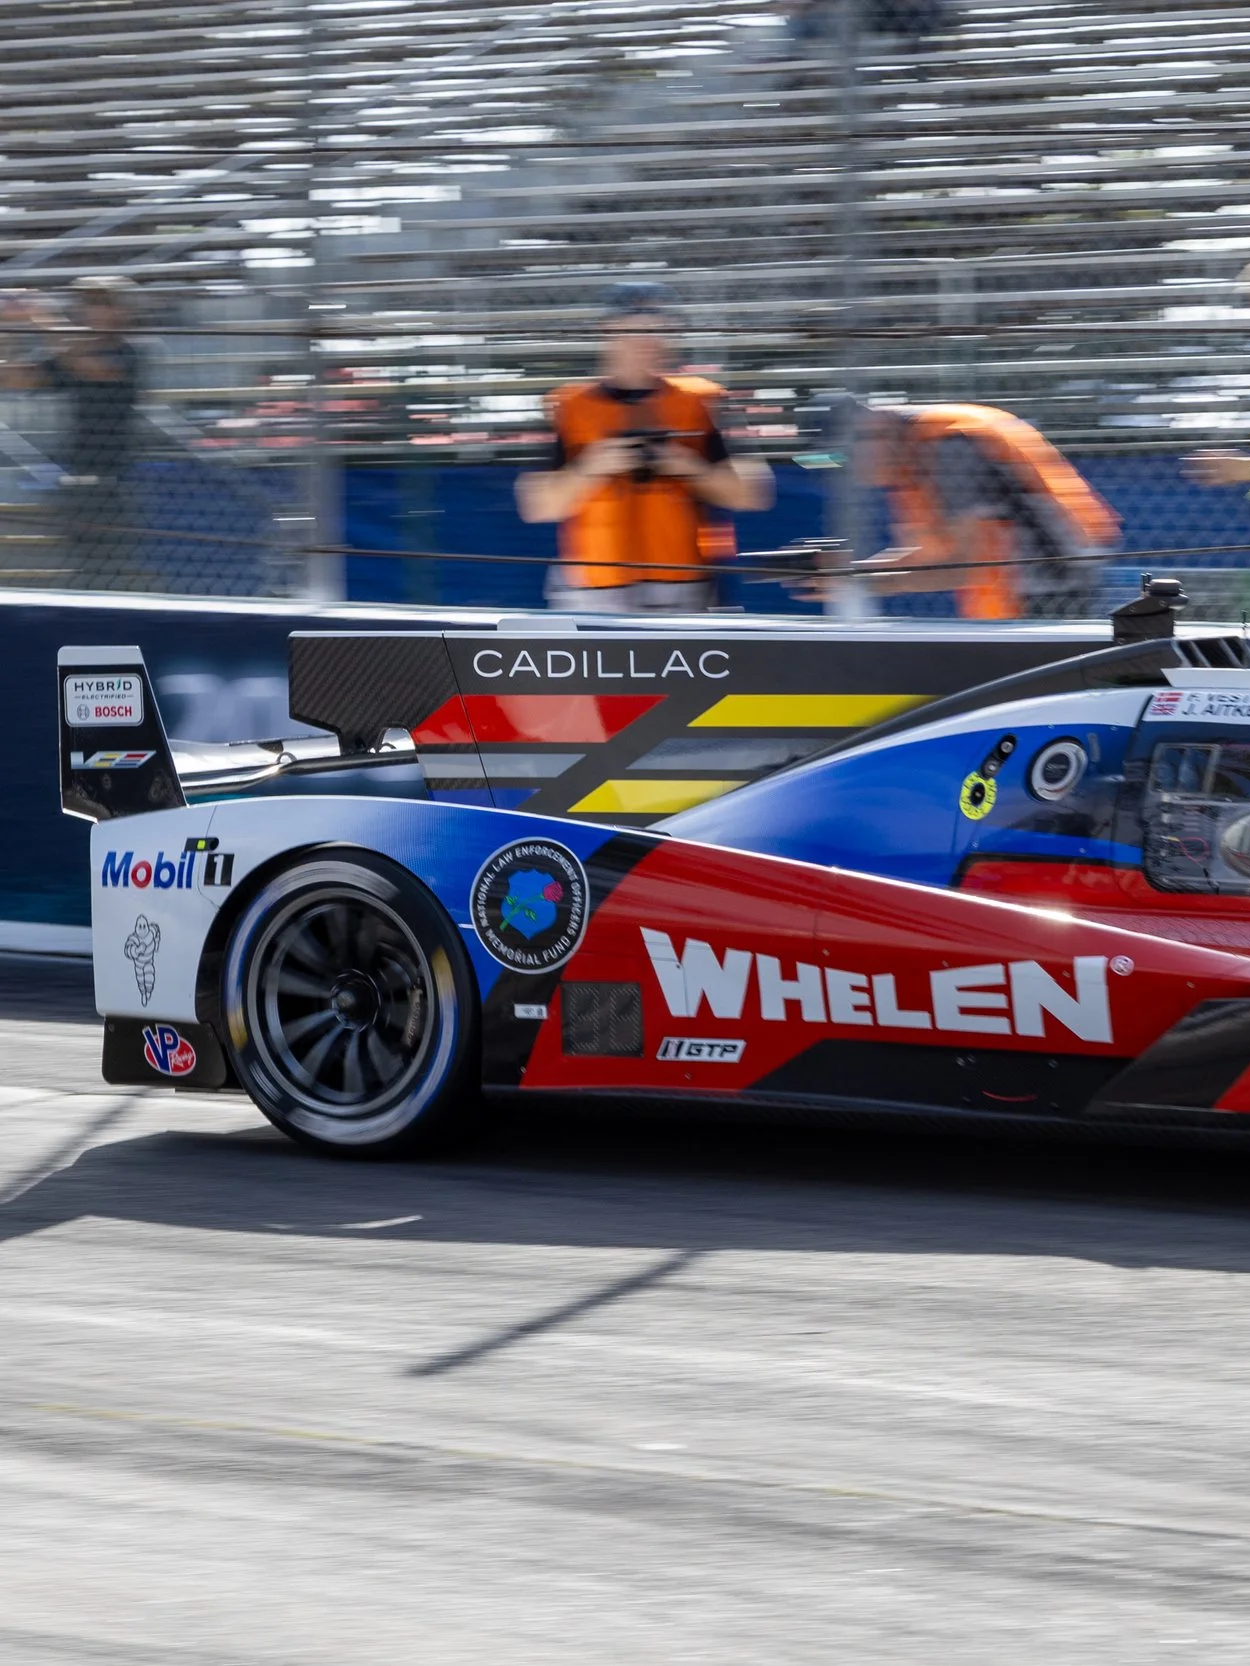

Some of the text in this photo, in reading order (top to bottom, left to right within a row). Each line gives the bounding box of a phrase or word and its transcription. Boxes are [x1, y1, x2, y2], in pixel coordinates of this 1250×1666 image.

[473, 650, 730, 678] CADILLAC
[74, 677, 132, 692] HYBRID
[95, 705, 132, 717] BOSCH
[102, 851, 196, 889] Mobil
[492, 852, 514, 873] LAW
[515, 845, 578, 882] ENFORCEMENT
[485, 929, 572, 965] MEMORIAL FUND
[639, 926, 1114, 1044] WHELEN
[142, 1024, 180, 1073] VP
[685, 1042, 738, 1057] GTP
